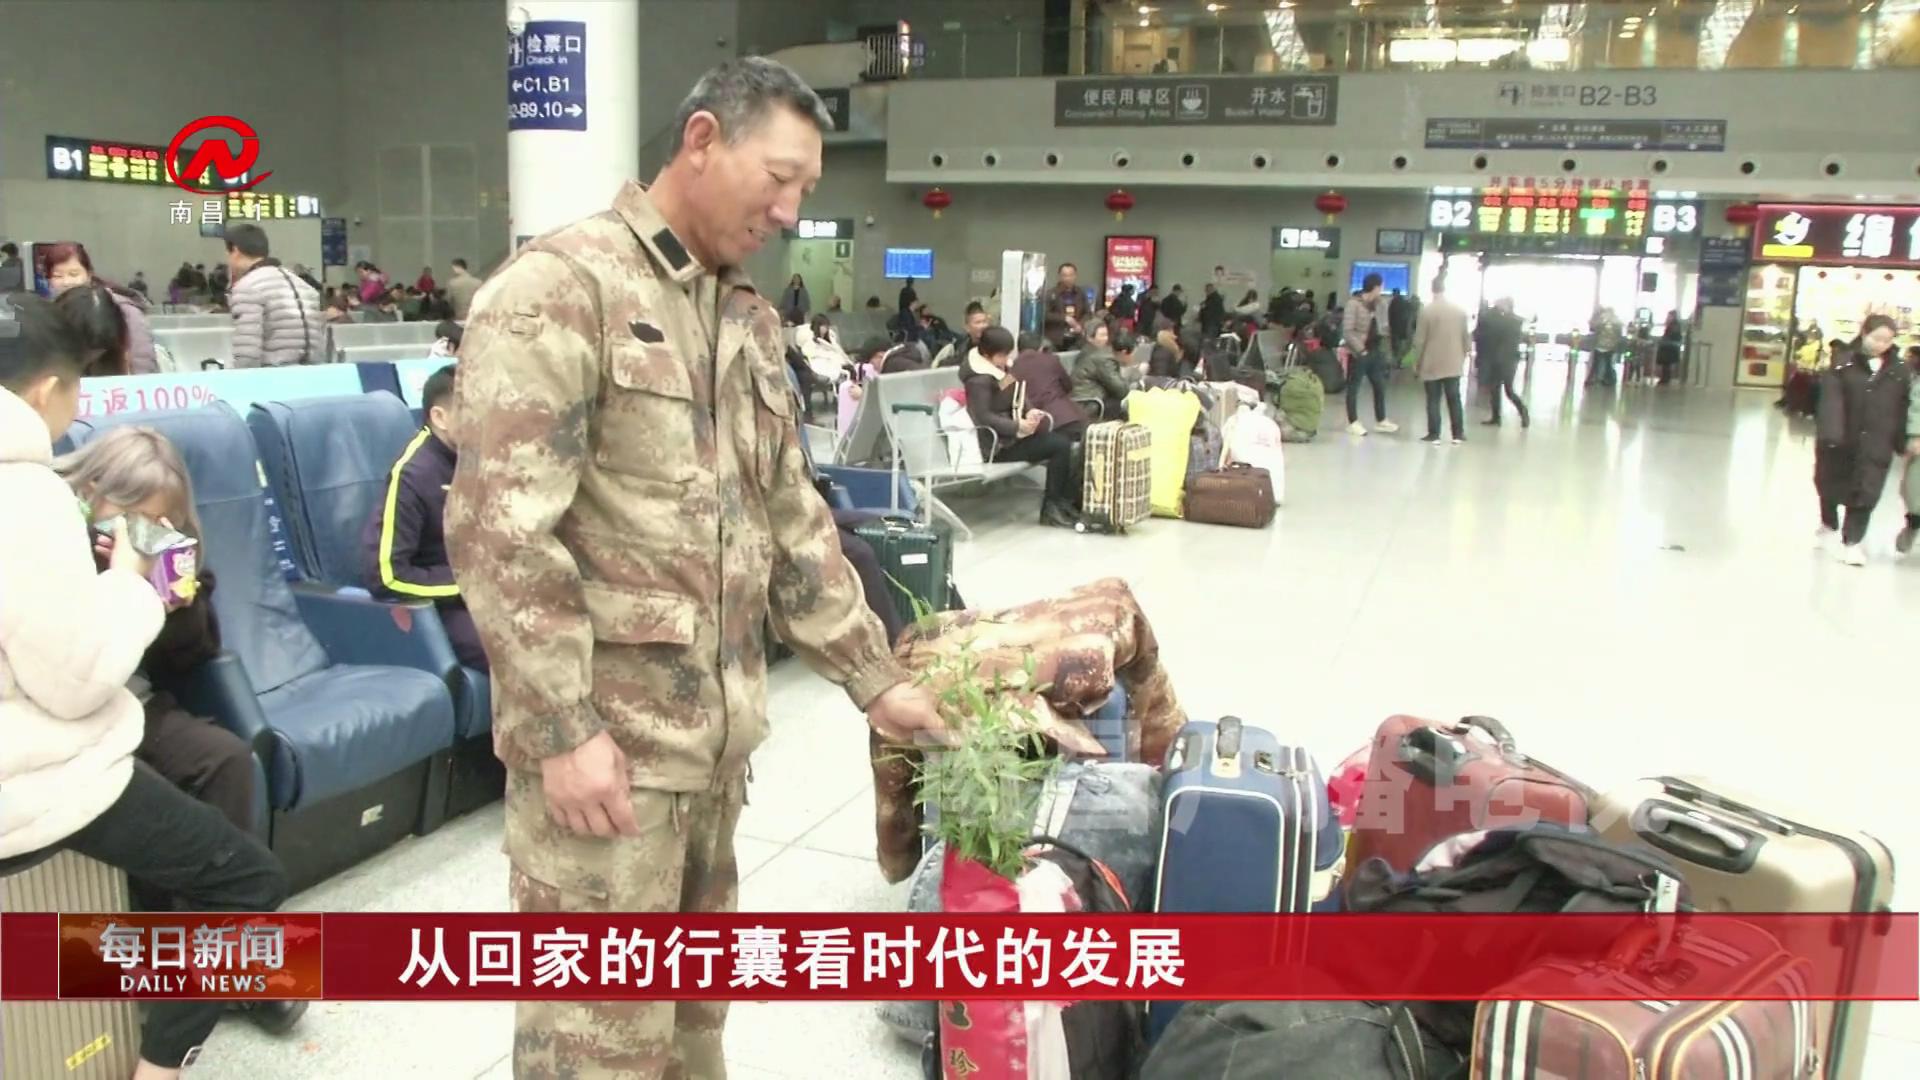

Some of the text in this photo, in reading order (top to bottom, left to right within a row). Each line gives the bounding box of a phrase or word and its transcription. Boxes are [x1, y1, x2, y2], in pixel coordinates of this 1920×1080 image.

[526, 33, 581, 53] 检票口
[1251, 87, 1287, 105] 开水
[1579, 84, 1657, 107] B2-B3
[53, 146, 83, 172] B1
[1429, 199, 1473, 228] B2
[1652, 204, 1698, 233] B3
